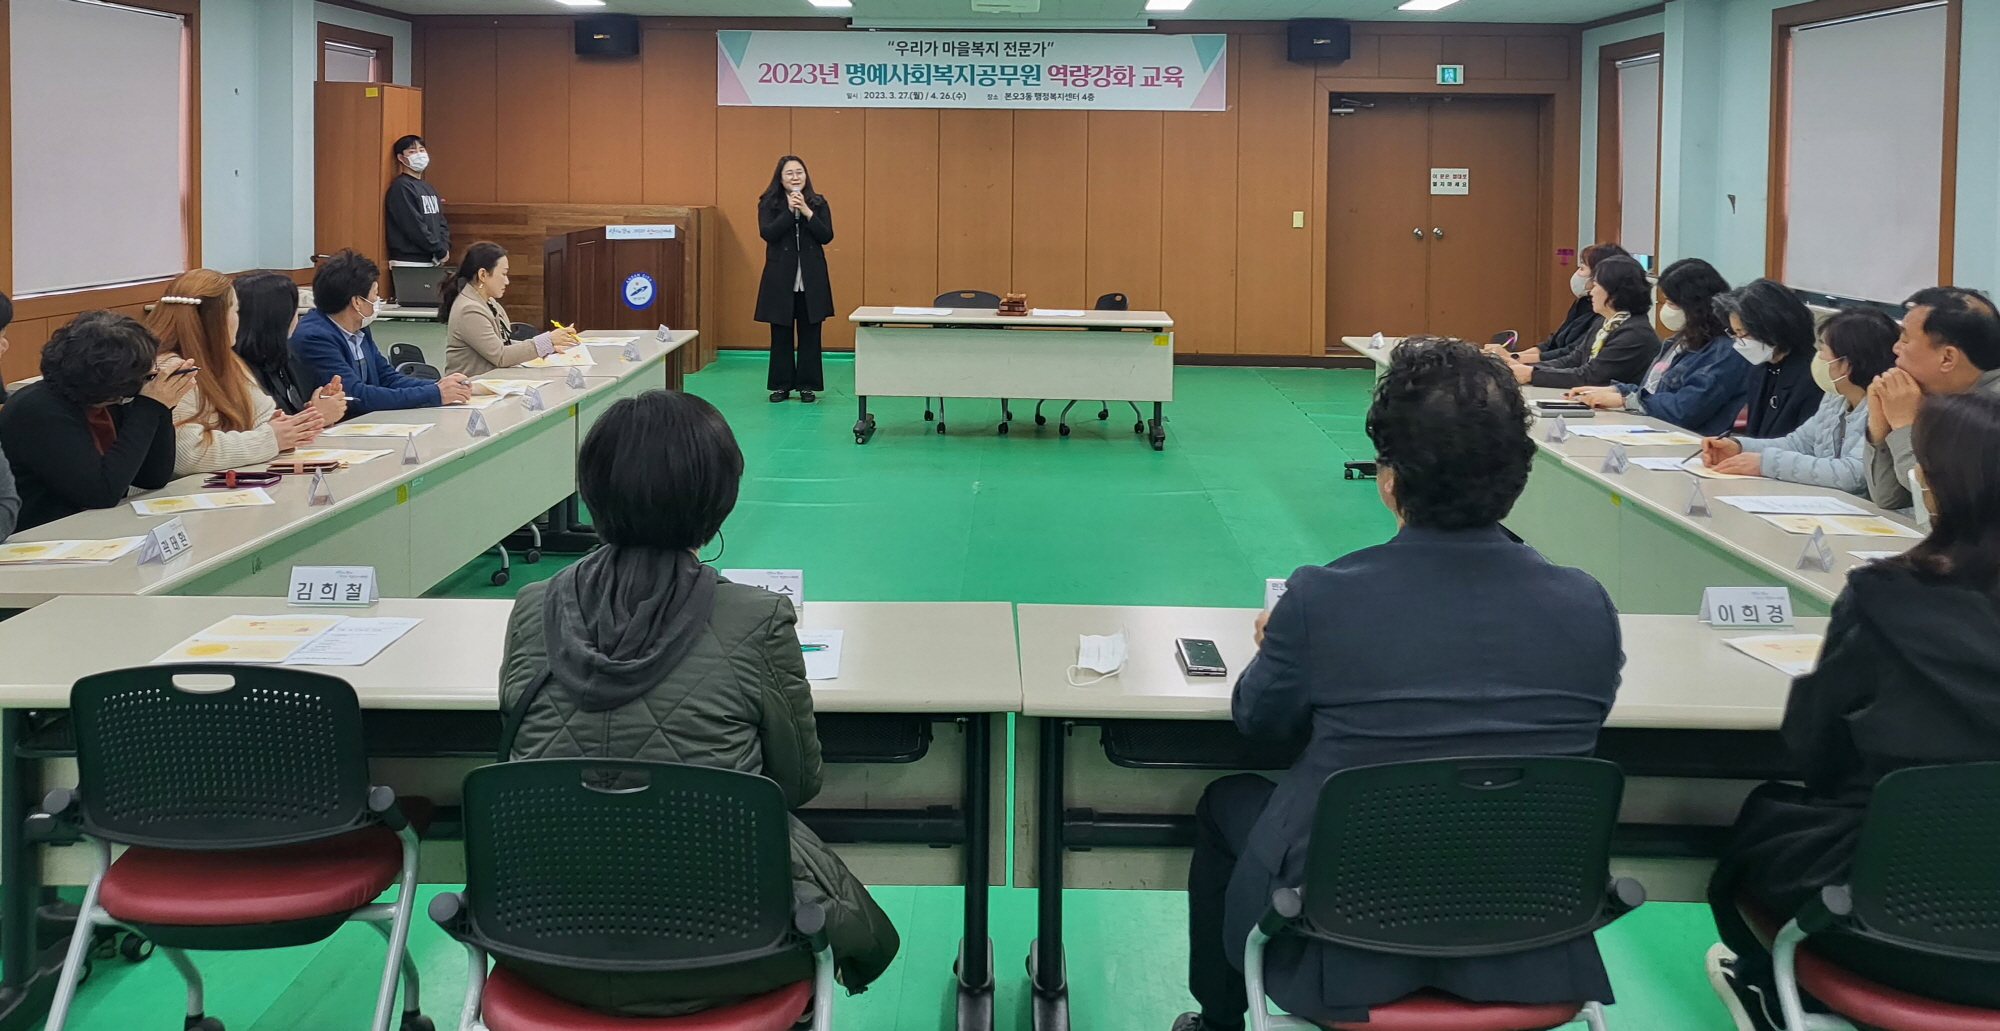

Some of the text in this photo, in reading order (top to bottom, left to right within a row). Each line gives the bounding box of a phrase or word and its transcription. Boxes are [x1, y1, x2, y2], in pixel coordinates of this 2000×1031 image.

[888, 40, 1054, 57] "우리가 마을복지 전문가"
[758, 62, 1185, 88] 2023년 명예사회복지공무원 역량강화 교육
[1004, 92, 1033, 101] 본오3동
[1034, 92, 1080, 101] 행정복지센터
[1081, 92, 1095, 101] 4층
